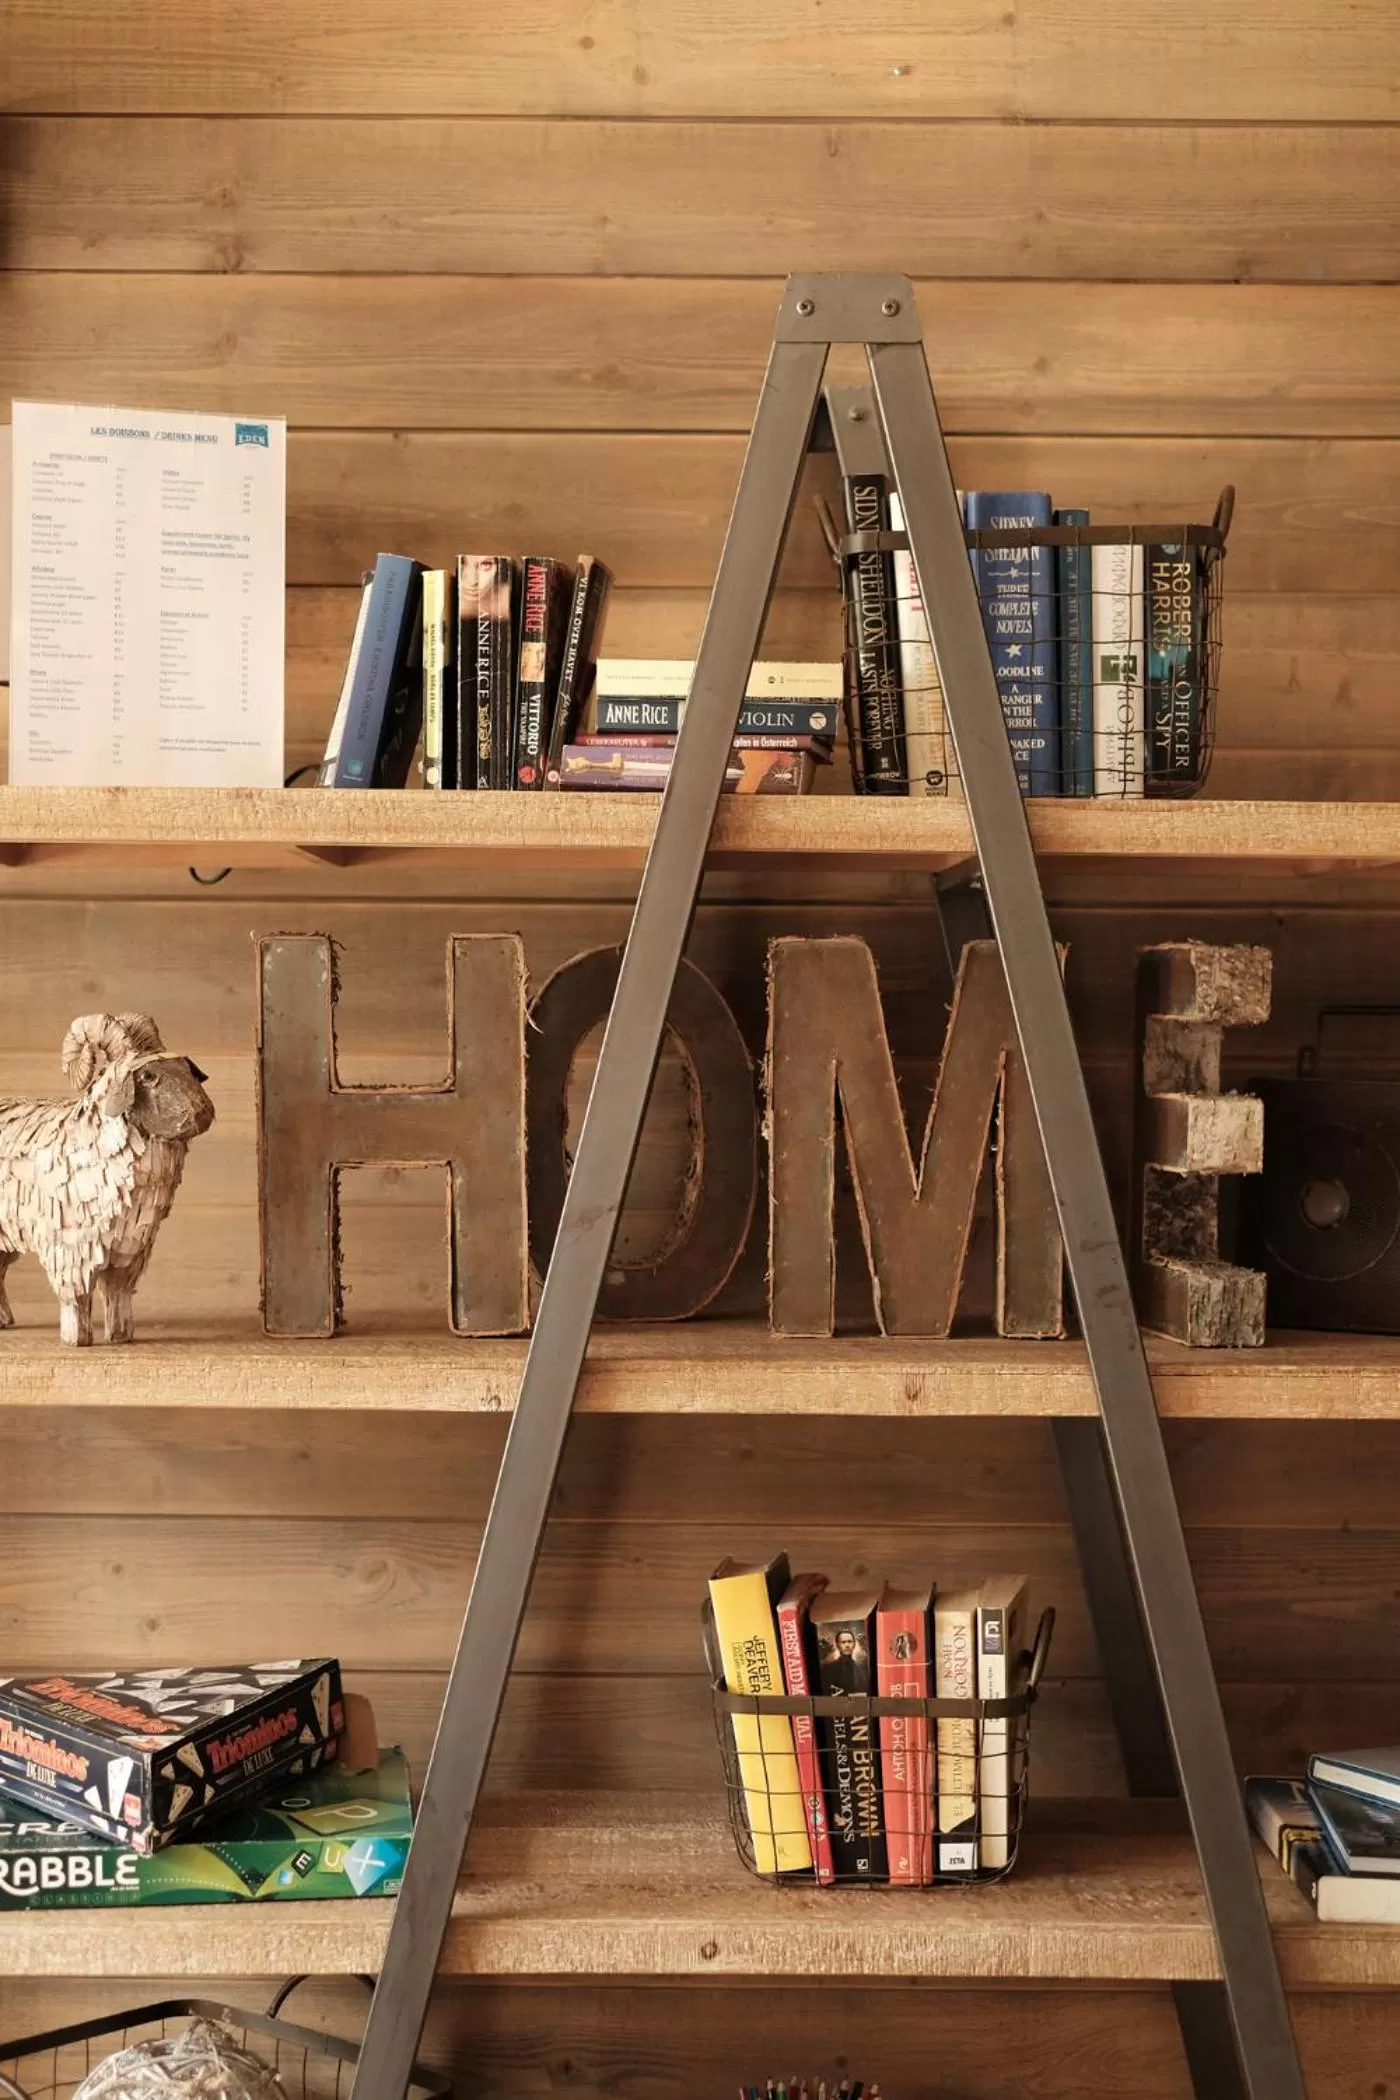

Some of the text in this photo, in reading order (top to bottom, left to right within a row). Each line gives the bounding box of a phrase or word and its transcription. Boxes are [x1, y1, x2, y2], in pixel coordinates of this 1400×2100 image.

[854, 485, 888, 645] SIDN SHELDON
[525, 564, 548, 632] ANNE RICE
[575, 591, 586, 614] KOM
[989, 601, 1039, 617] COMPLETE
[1152, 562, 1172, 657] HARRIS
[1172, 562, 1192, 652] ROBERT
[477, 610, 492, 656] ANNE
[570, 616, 582, 645] OVER
[996, 619, 1033, 634] NOVELS
[476, 659, 491, 699] RICE
[564, 647, 577, 682] HAVET
[860, 652, 879, 693] LASTS
[997, 666, 1045, 677] OODLINE
[605, 703, 669, 725] ANNE RICE
[739, 711, 795, 727] VIOLIN
[1001, 694, 1044, 705] RANGER
[1012, 706, 1032, 716] THE
[518, 701, 529, 746] THE VAMPIRE
[527, 693, 542, 756] VITTORIO
[761, 735, 798, 748] Österreich
[1005, 718, 1038, 728] RROR
[1010, 739, 1046, 749] NAKED
[1156, 711, 1173, 749] SPY
[1175, 680, 1193, 769] OFFICER
[253, 928, 1273, 1349] HOME
[743, 1640, 762, 1694] DEAVER
[753, 1635, 773, 1692] JEFFERY
[782, 1619, 813, 1744] FIRST AID MUAL
[953, 1624, 967, 1699] GORDON
[829, 1684, 848, 1754] AGELS
[890, 1683, 906, 1731] ООВ
[0, 1717, 90, 1782] Triominos
[206, 1709, 298, 1775] Triominos
[848, 1691, 880, 1839] AN BROWN
